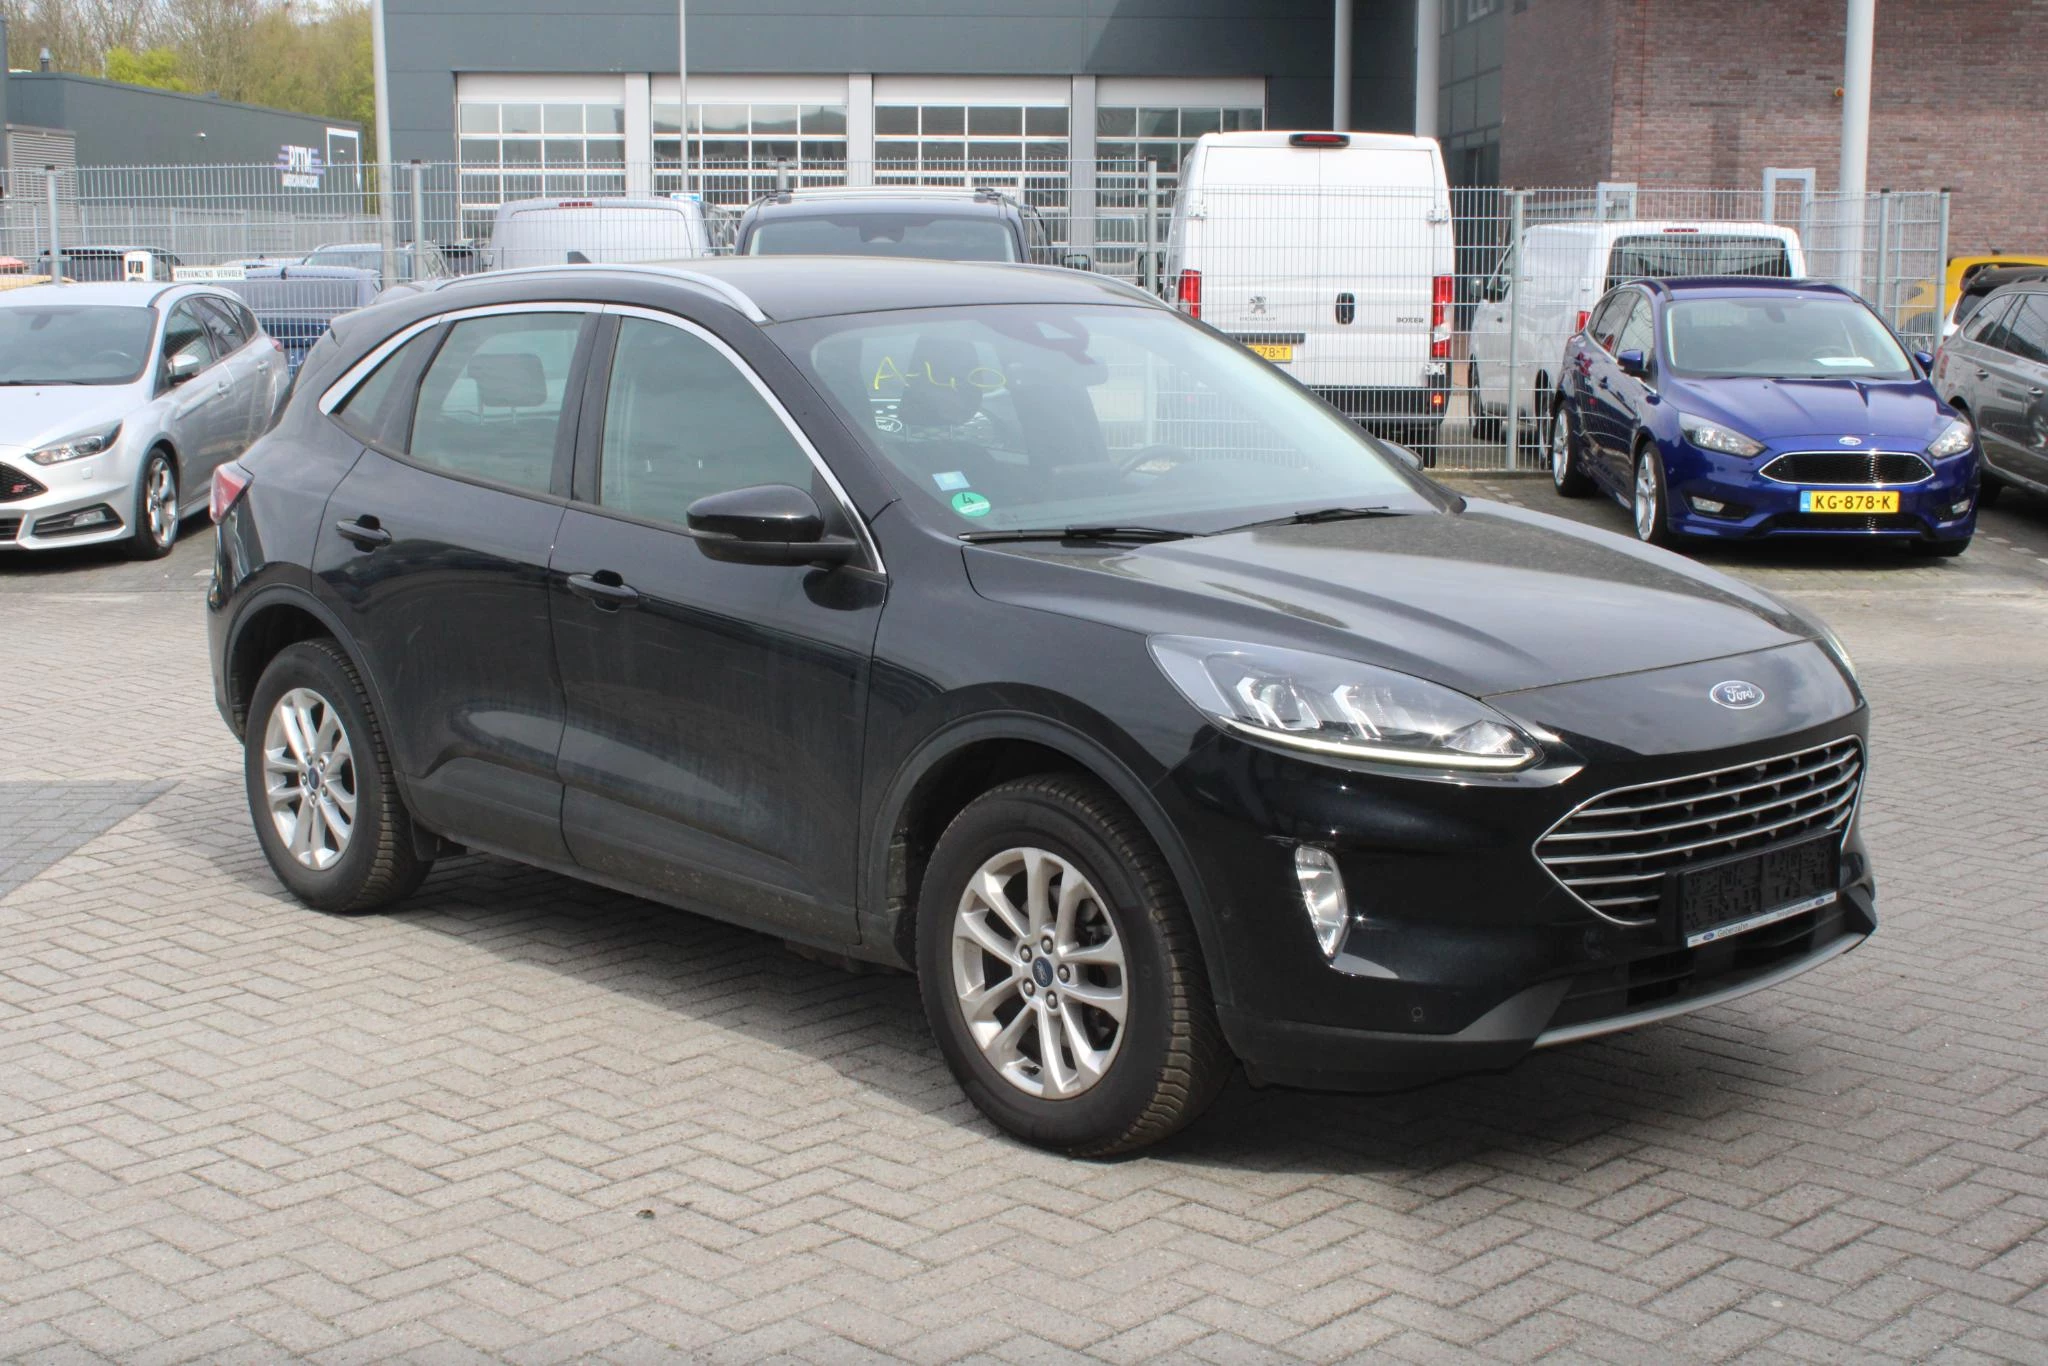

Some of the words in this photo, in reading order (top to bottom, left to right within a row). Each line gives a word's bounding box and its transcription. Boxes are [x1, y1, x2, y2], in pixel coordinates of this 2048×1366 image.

[961, 493, 975, 504] 4
[1815, 496, 1890, 510] KG-878-K
[1724, 685, 1756, 702] Ford
